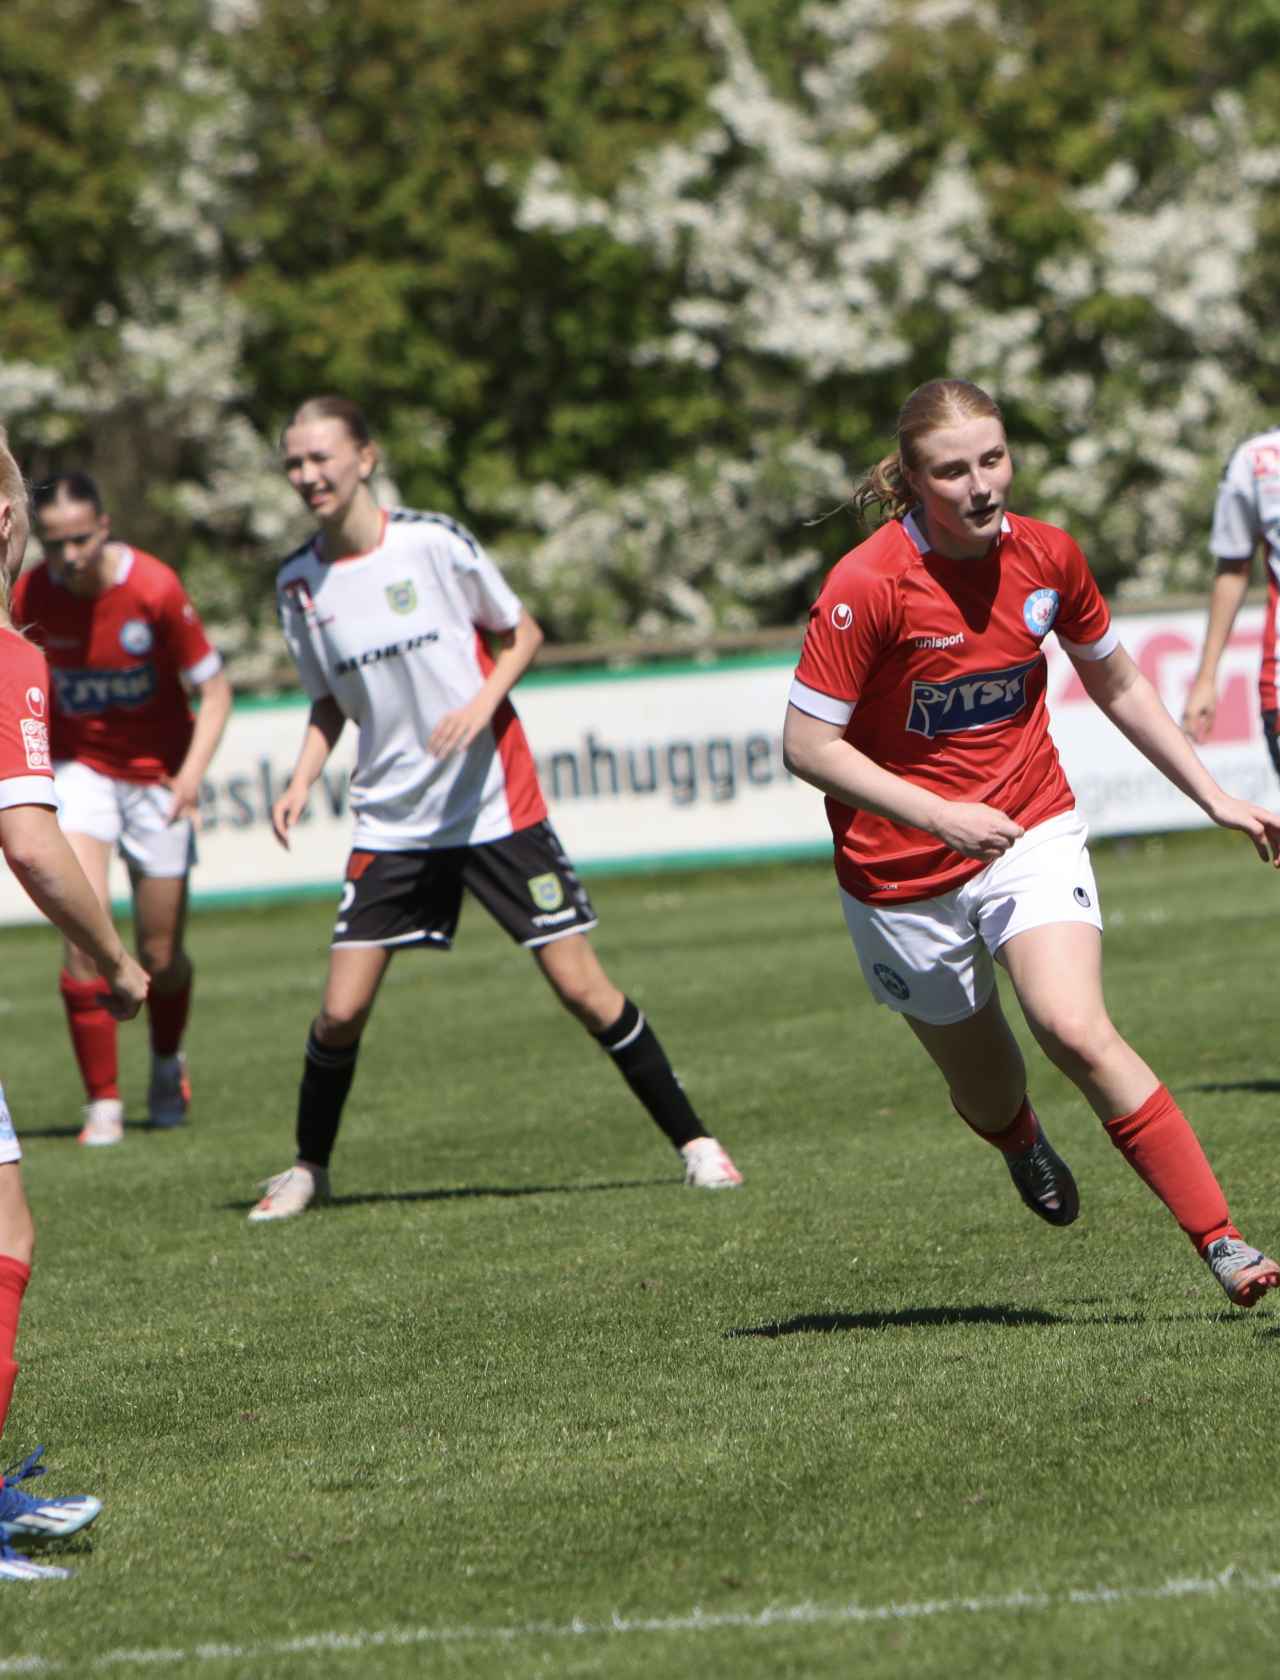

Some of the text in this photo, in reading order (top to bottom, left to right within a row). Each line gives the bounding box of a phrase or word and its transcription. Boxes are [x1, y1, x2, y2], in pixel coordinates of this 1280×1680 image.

[915, 632, 965, 649] uhlsport
[197, 728, 794, 832] eslv nhugge
